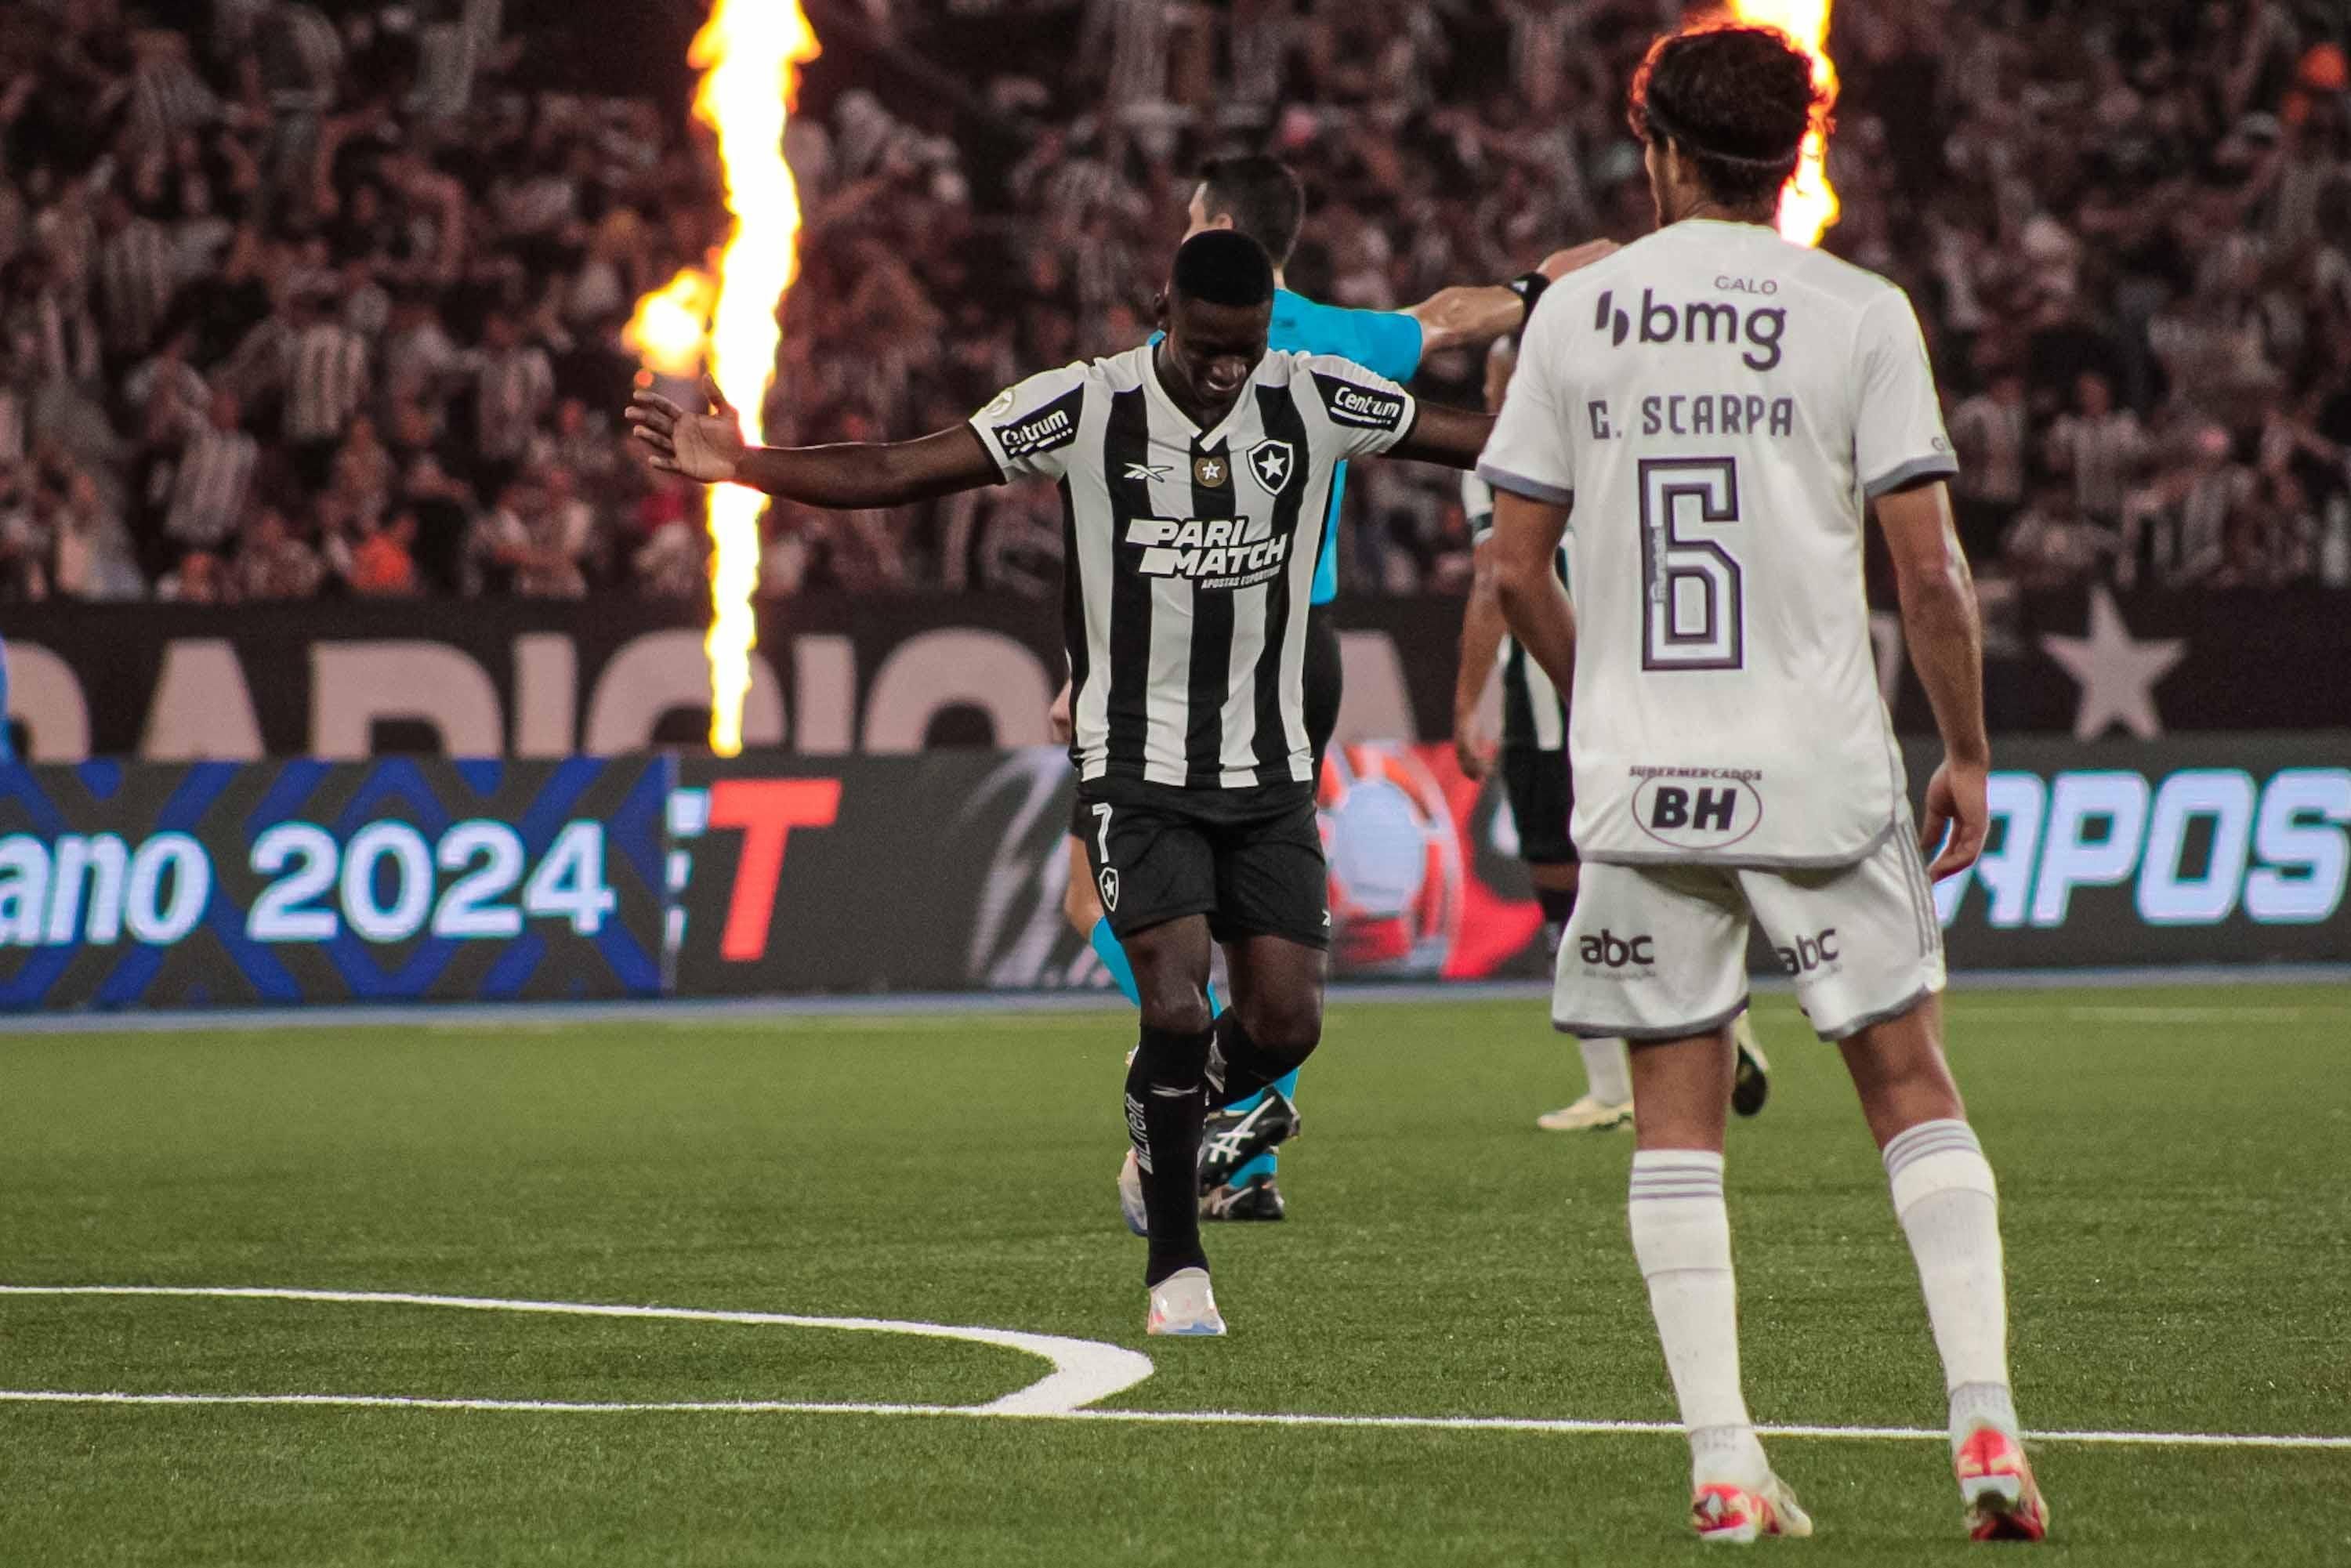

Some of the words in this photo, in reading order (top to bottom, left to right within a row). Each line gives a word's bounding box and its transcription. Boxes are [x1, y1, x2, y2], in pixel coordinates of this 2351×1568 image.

[1639, 288, 1788, 372] bmg
[1642, 394, 1793, 436] SCARPA
[1125, 518, 1245, 547] PARI
[1139, 533, 1288, 576] MATCH
[1638, 456, 1743, 672] 6
[1651, 786, 1737, 831] BH
[1092, 802, 1113, 864] 7
[246, 819, 614, 942] 2024
[1579, 928, 1656, 969] abc
